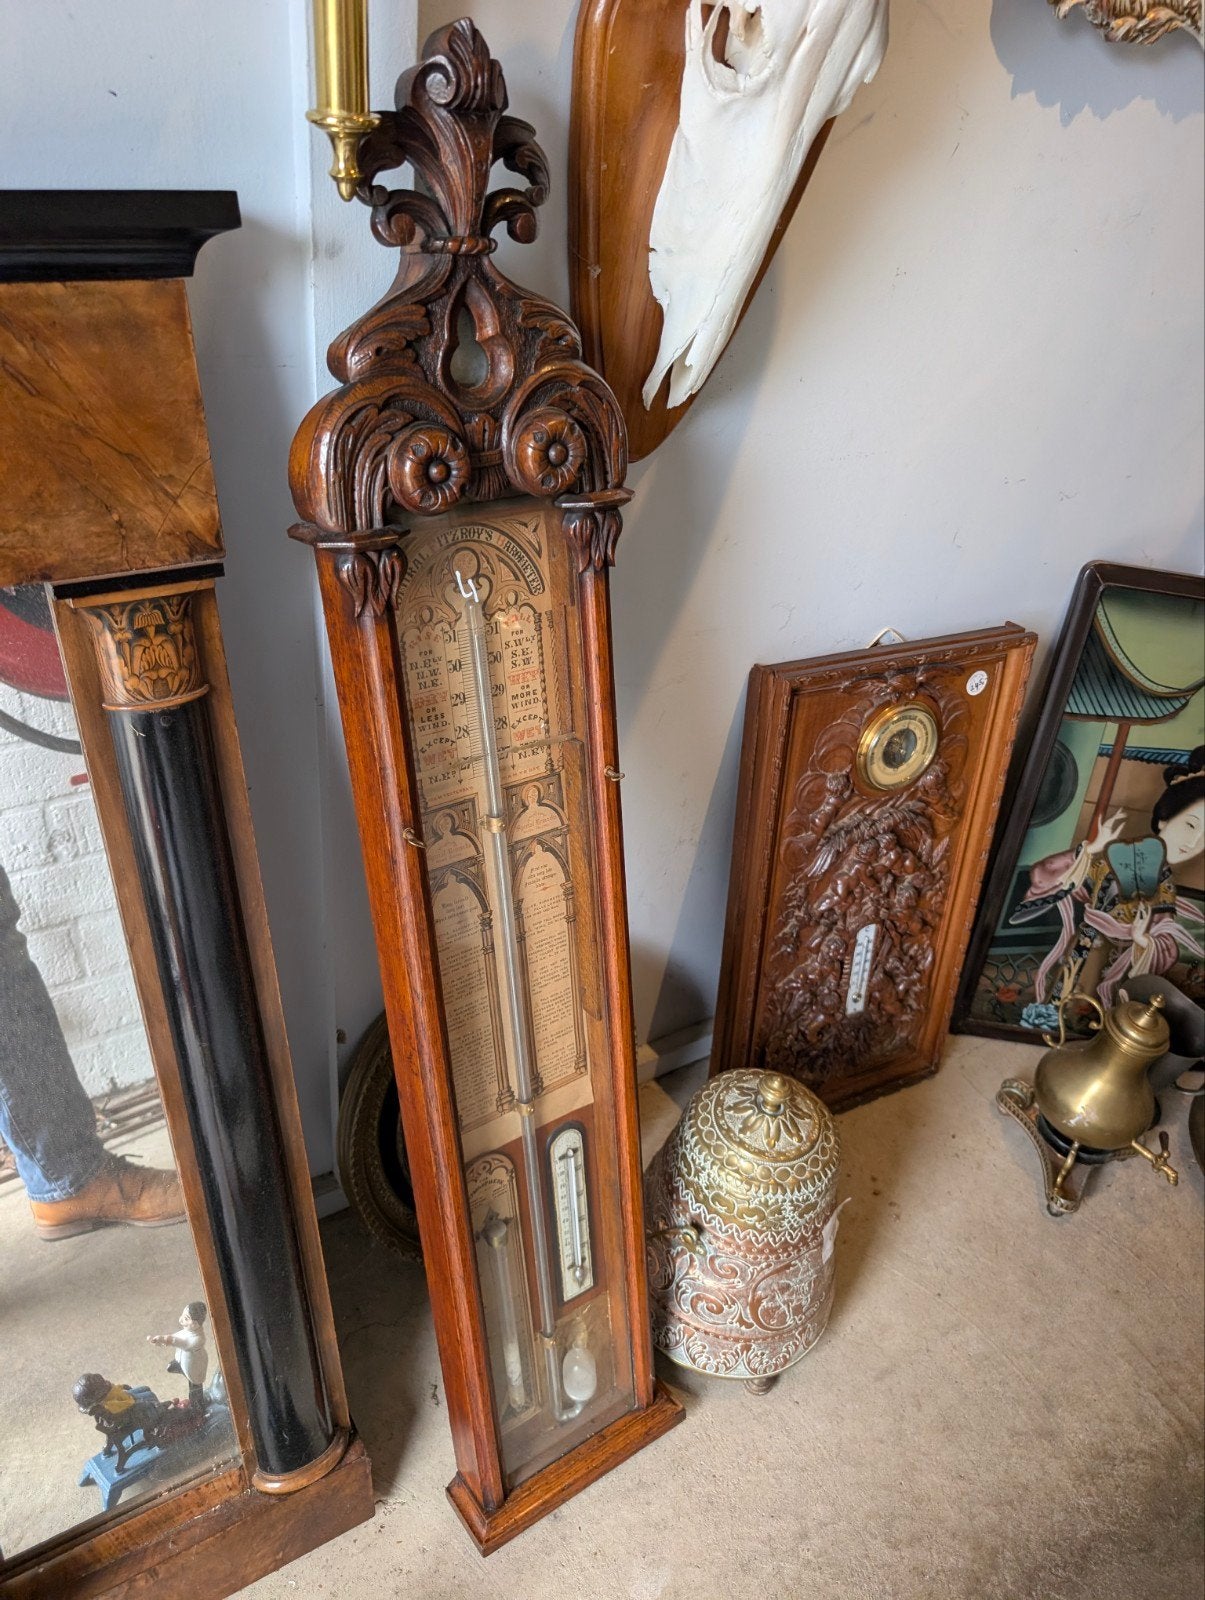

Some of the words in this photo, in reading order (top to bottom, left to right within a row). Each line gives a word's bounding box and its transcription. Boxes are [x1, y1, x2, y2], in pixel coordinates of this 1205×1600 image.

[511, 629, 524, 637] FOR
[418, 649, 433, 657] FOR
[451, 692, 466, 708] 29
[511, 689, 538, 701] MORE
[425, 706, 436, 714] OR
[420, 713, 445, 724] LESS
[511, 714, 544, 730] EXCEPT
[420, 737, 456, 754] EXCEPT
